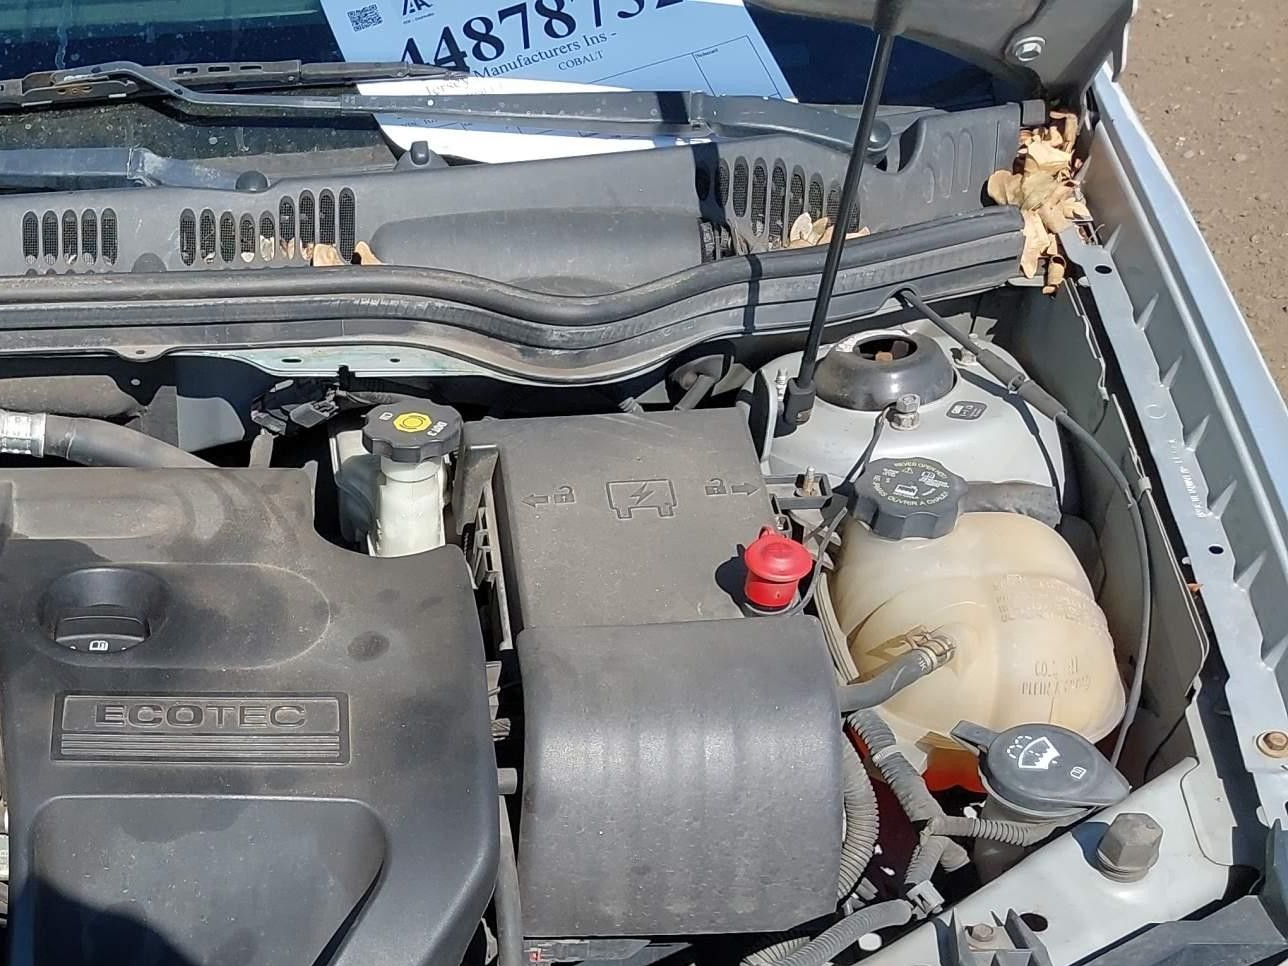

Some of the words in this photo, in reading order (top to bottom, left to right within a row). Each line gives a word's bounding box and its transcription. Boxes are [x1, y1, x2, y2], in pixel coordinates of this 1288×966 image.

[473, 41, 580, 78] Manufacturers
[584, 32, 608, 47] Ins
[558, 50, 604, 71] COBALT
[95, 704, 307, 729] ECOTEC
